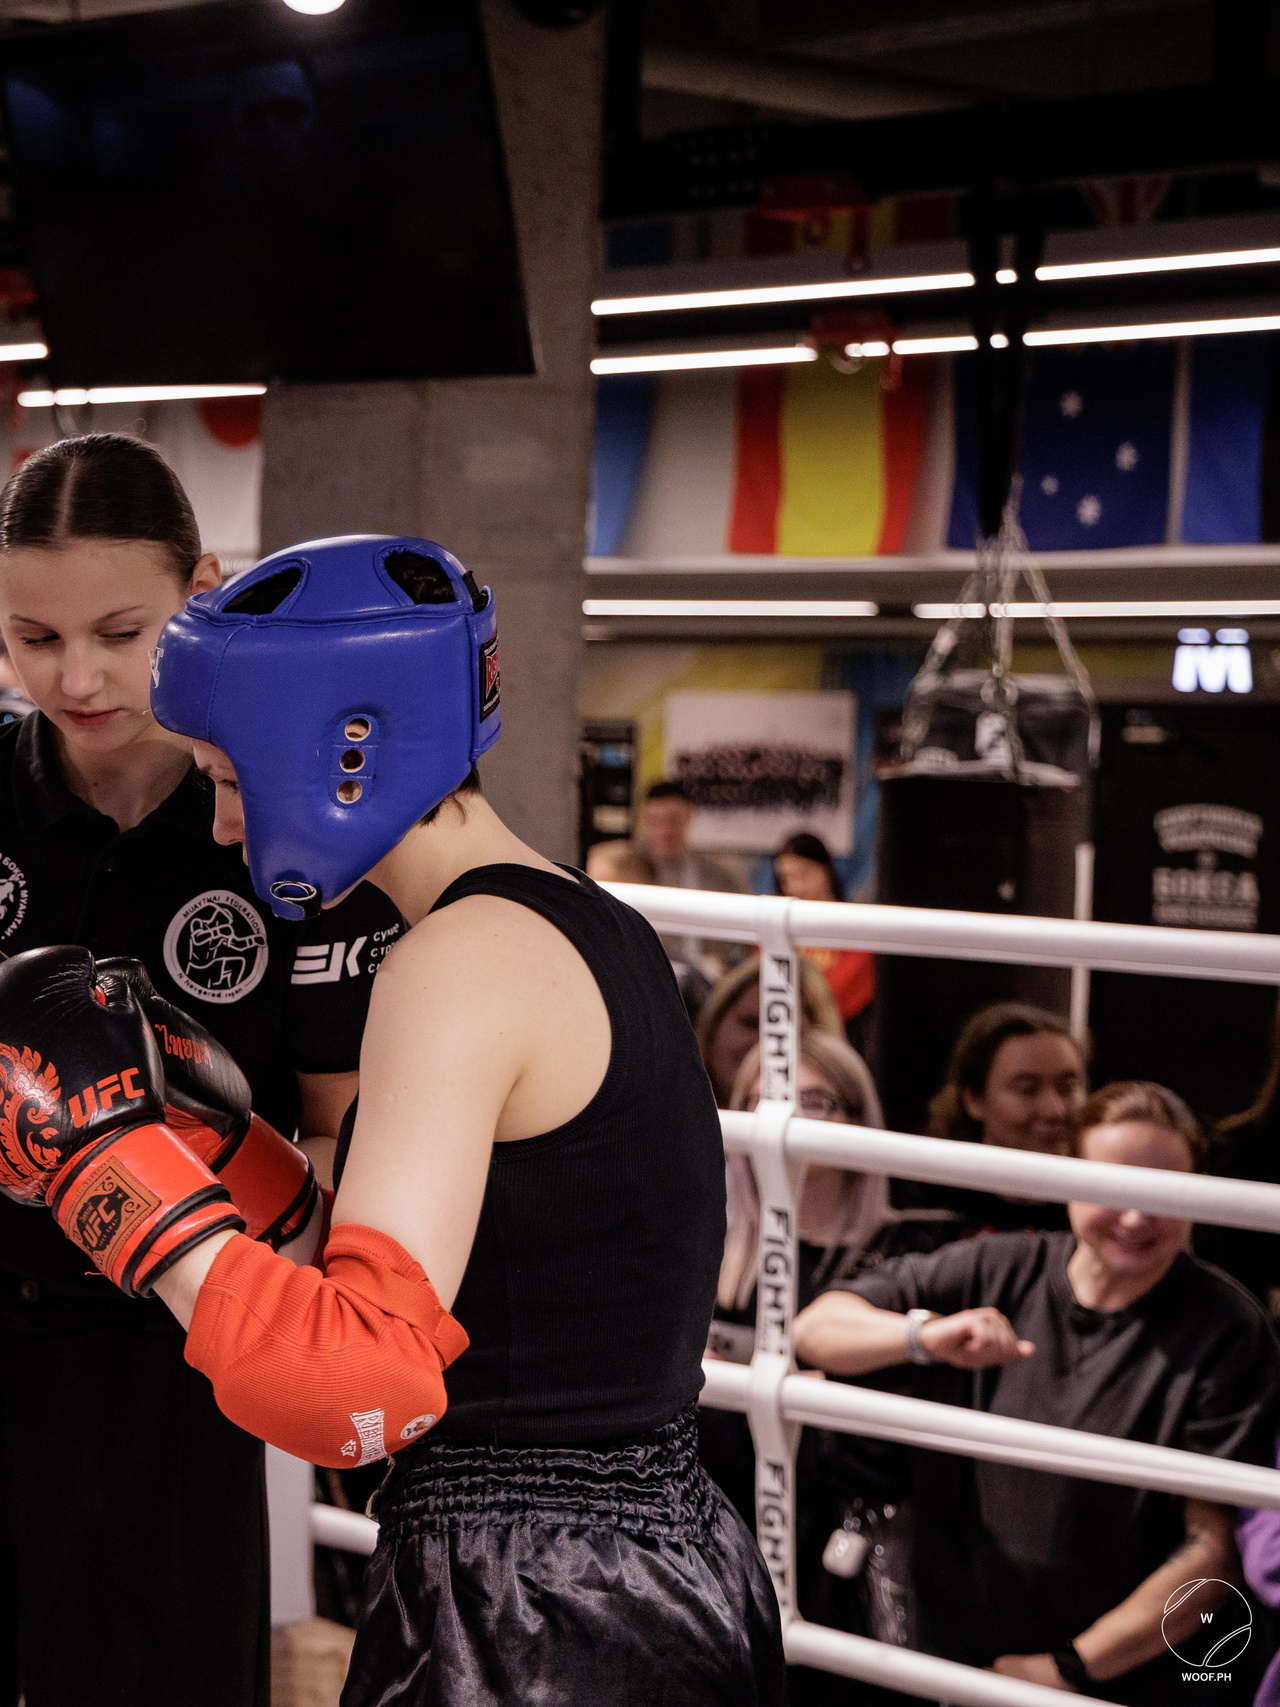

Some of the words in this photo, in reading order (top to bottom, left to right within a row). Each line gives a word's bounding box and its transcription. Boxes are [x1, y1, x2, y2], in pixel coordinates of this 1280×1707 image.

[1, 855, 27, 888] БОКСА
[225, 896, 261, 935] FEDERATION
[68, 1067, 145, 1128] UFC
[82, 1197, 117, 1248] UFC
